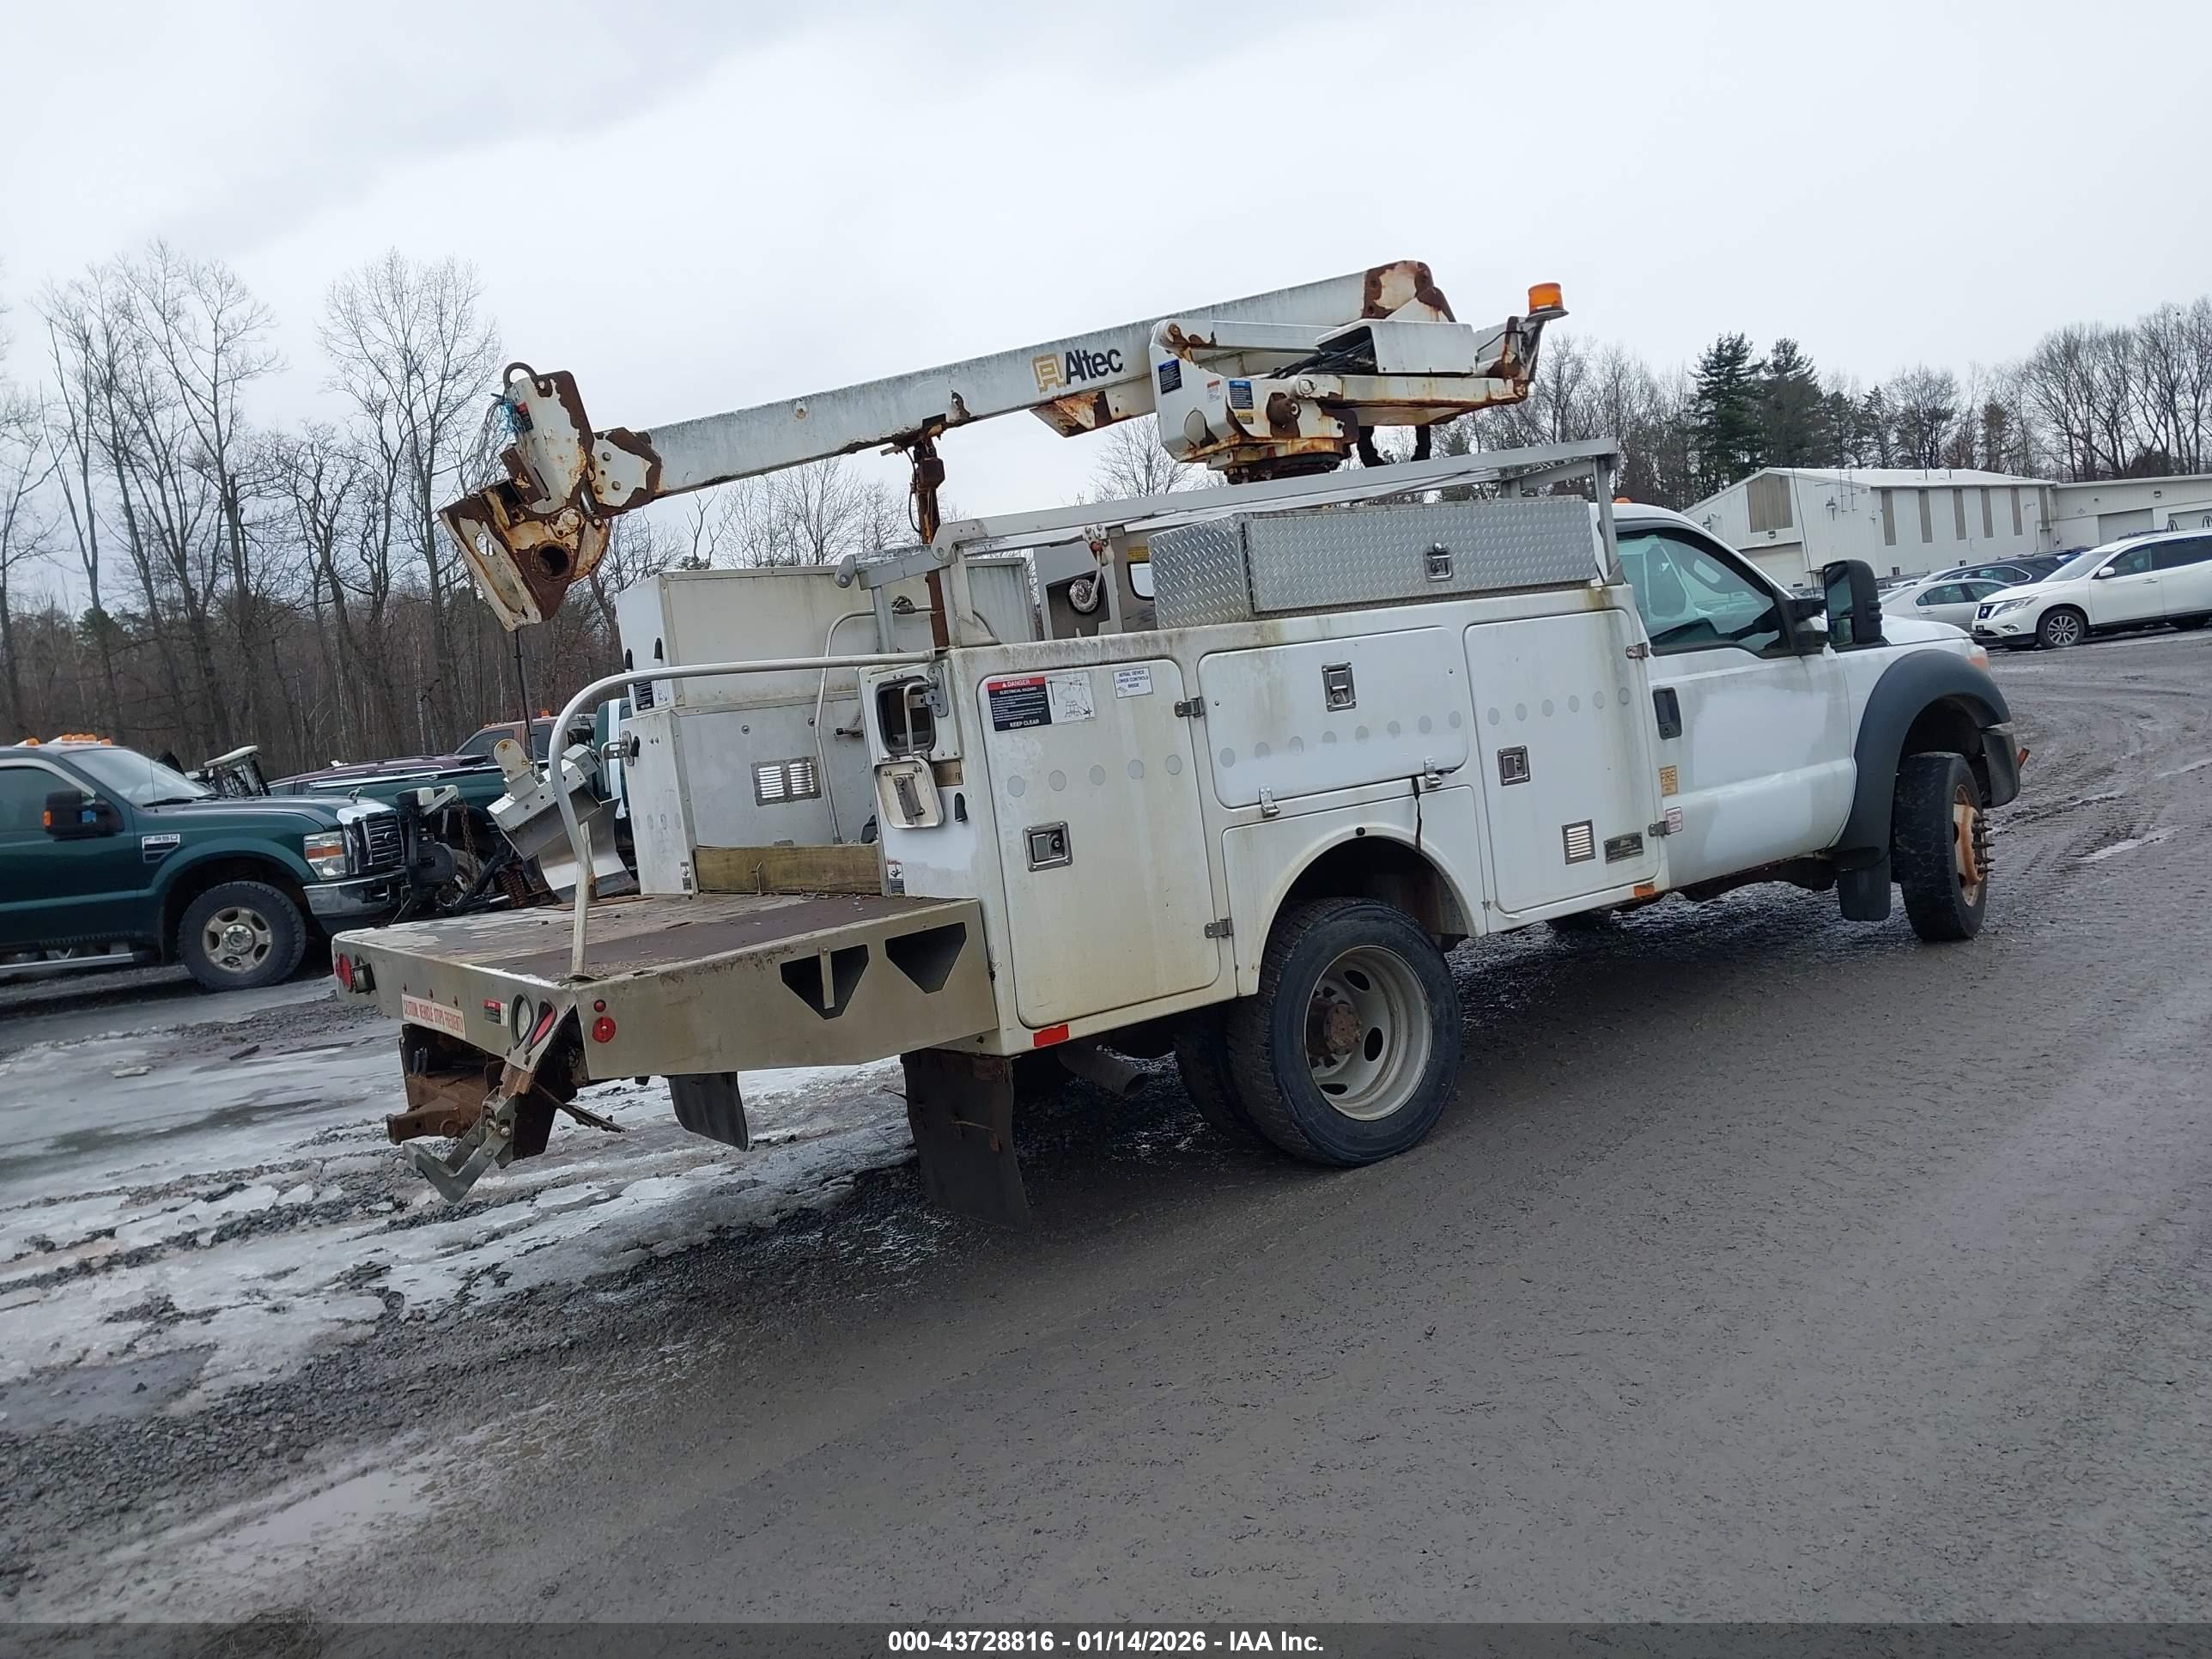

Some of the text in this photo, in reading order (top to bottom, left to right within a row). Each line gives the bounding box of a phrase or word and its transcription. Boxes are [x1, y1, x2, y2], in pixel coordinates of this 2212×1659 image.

[1065, 349, 1123, 385] Altec
[1006, 679, 1030, 688] DANGER
[1661, 769, 1676, 782] FIRE
[419, 1003, 434, 1022] VEHICLE
[434, 1007, 445, 1024] STOPS
